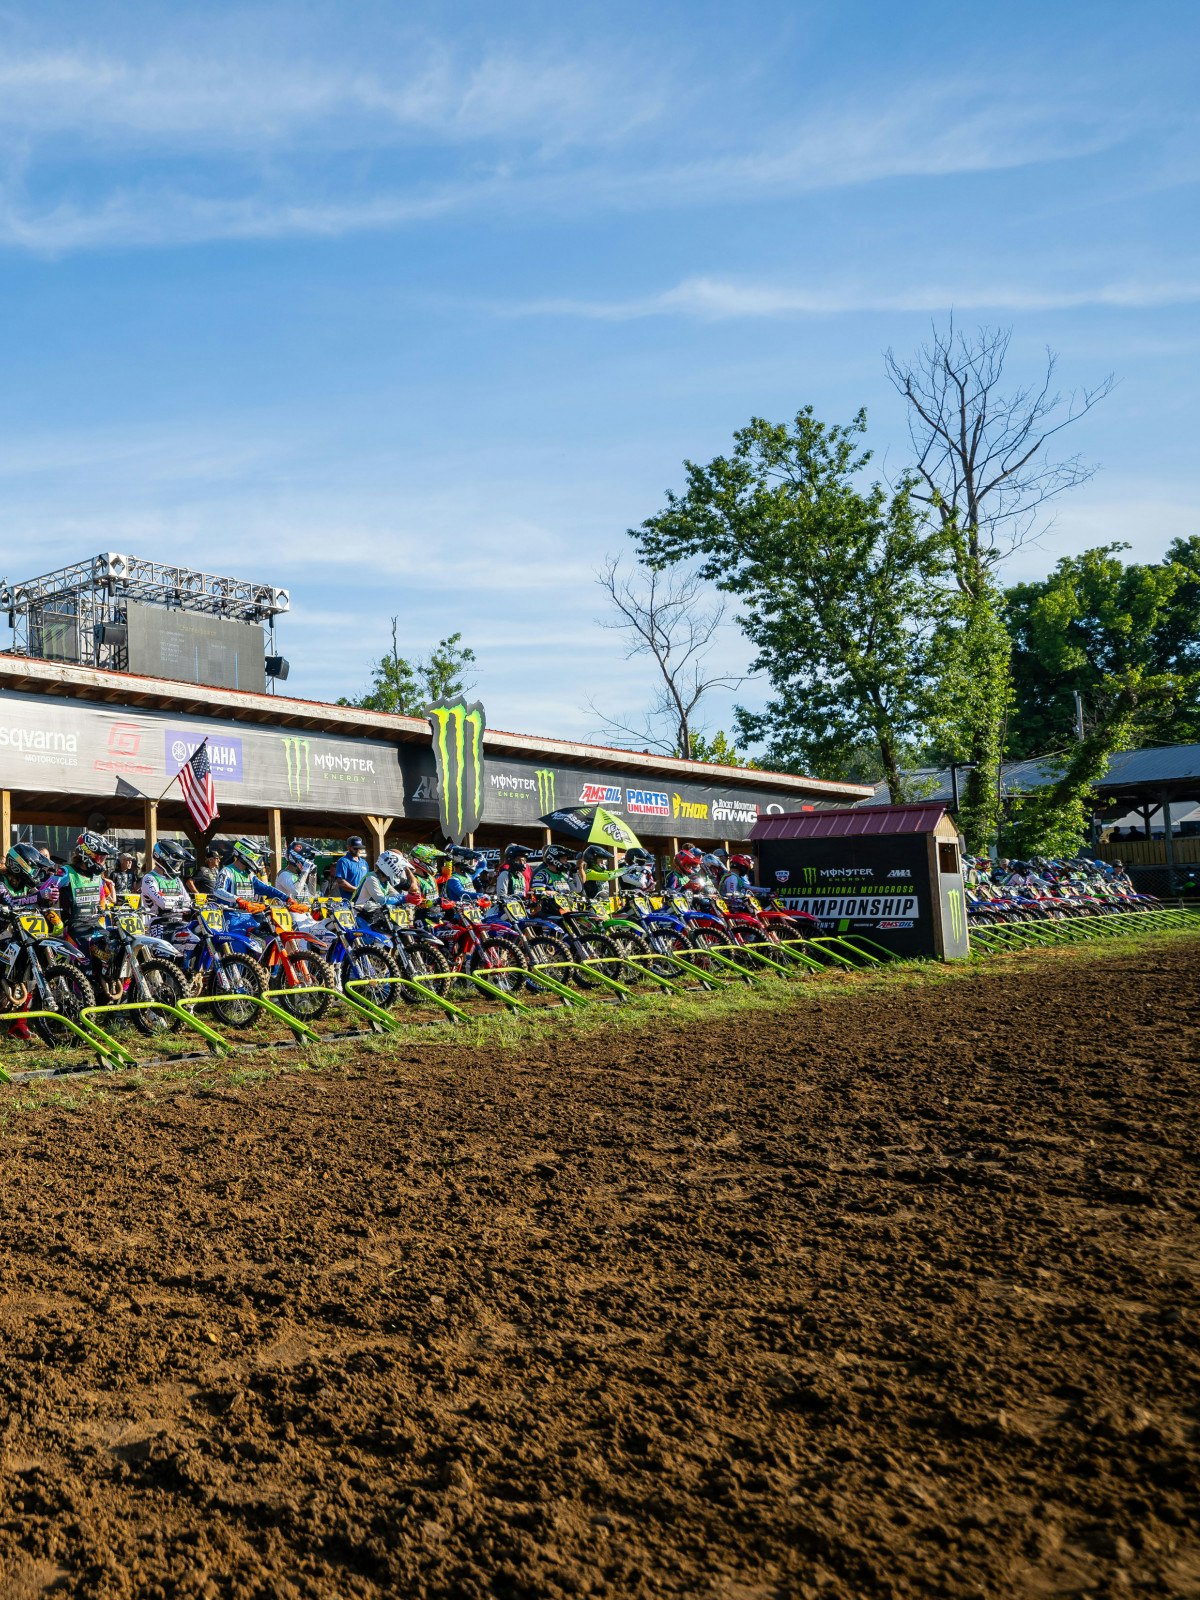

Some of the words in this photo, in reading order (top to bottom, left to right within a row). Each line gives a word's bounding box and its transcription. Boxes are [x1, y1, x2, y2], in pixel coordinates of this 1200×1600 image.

[25, 754, 78, 767] MOTORCYCLES
[314, 753, 375, 774] MONSTER
[324, 773, 366, 783] ENERGY
[491, 773, 537, 792] MONSTER
[498, 792, 530, 800] ENERGY
[581, 785, 622, 803] AMSOIL
[627, 790, 669, 807] PARTS
[627, 804, 669, 816] UNLIMITED
[681, 802, 708, 820] THOR
[820, 868, 874, 878] MONSTER
[816, 886, 856, 894] NATIONAL
[860, 885, 914, 893] MOTOCROSS
[26, 918, 45, 933] 27
[126, 919, 145, 934] 84
[207, 912, 222, 928] 42
[275, 912, 290, 927] 77
